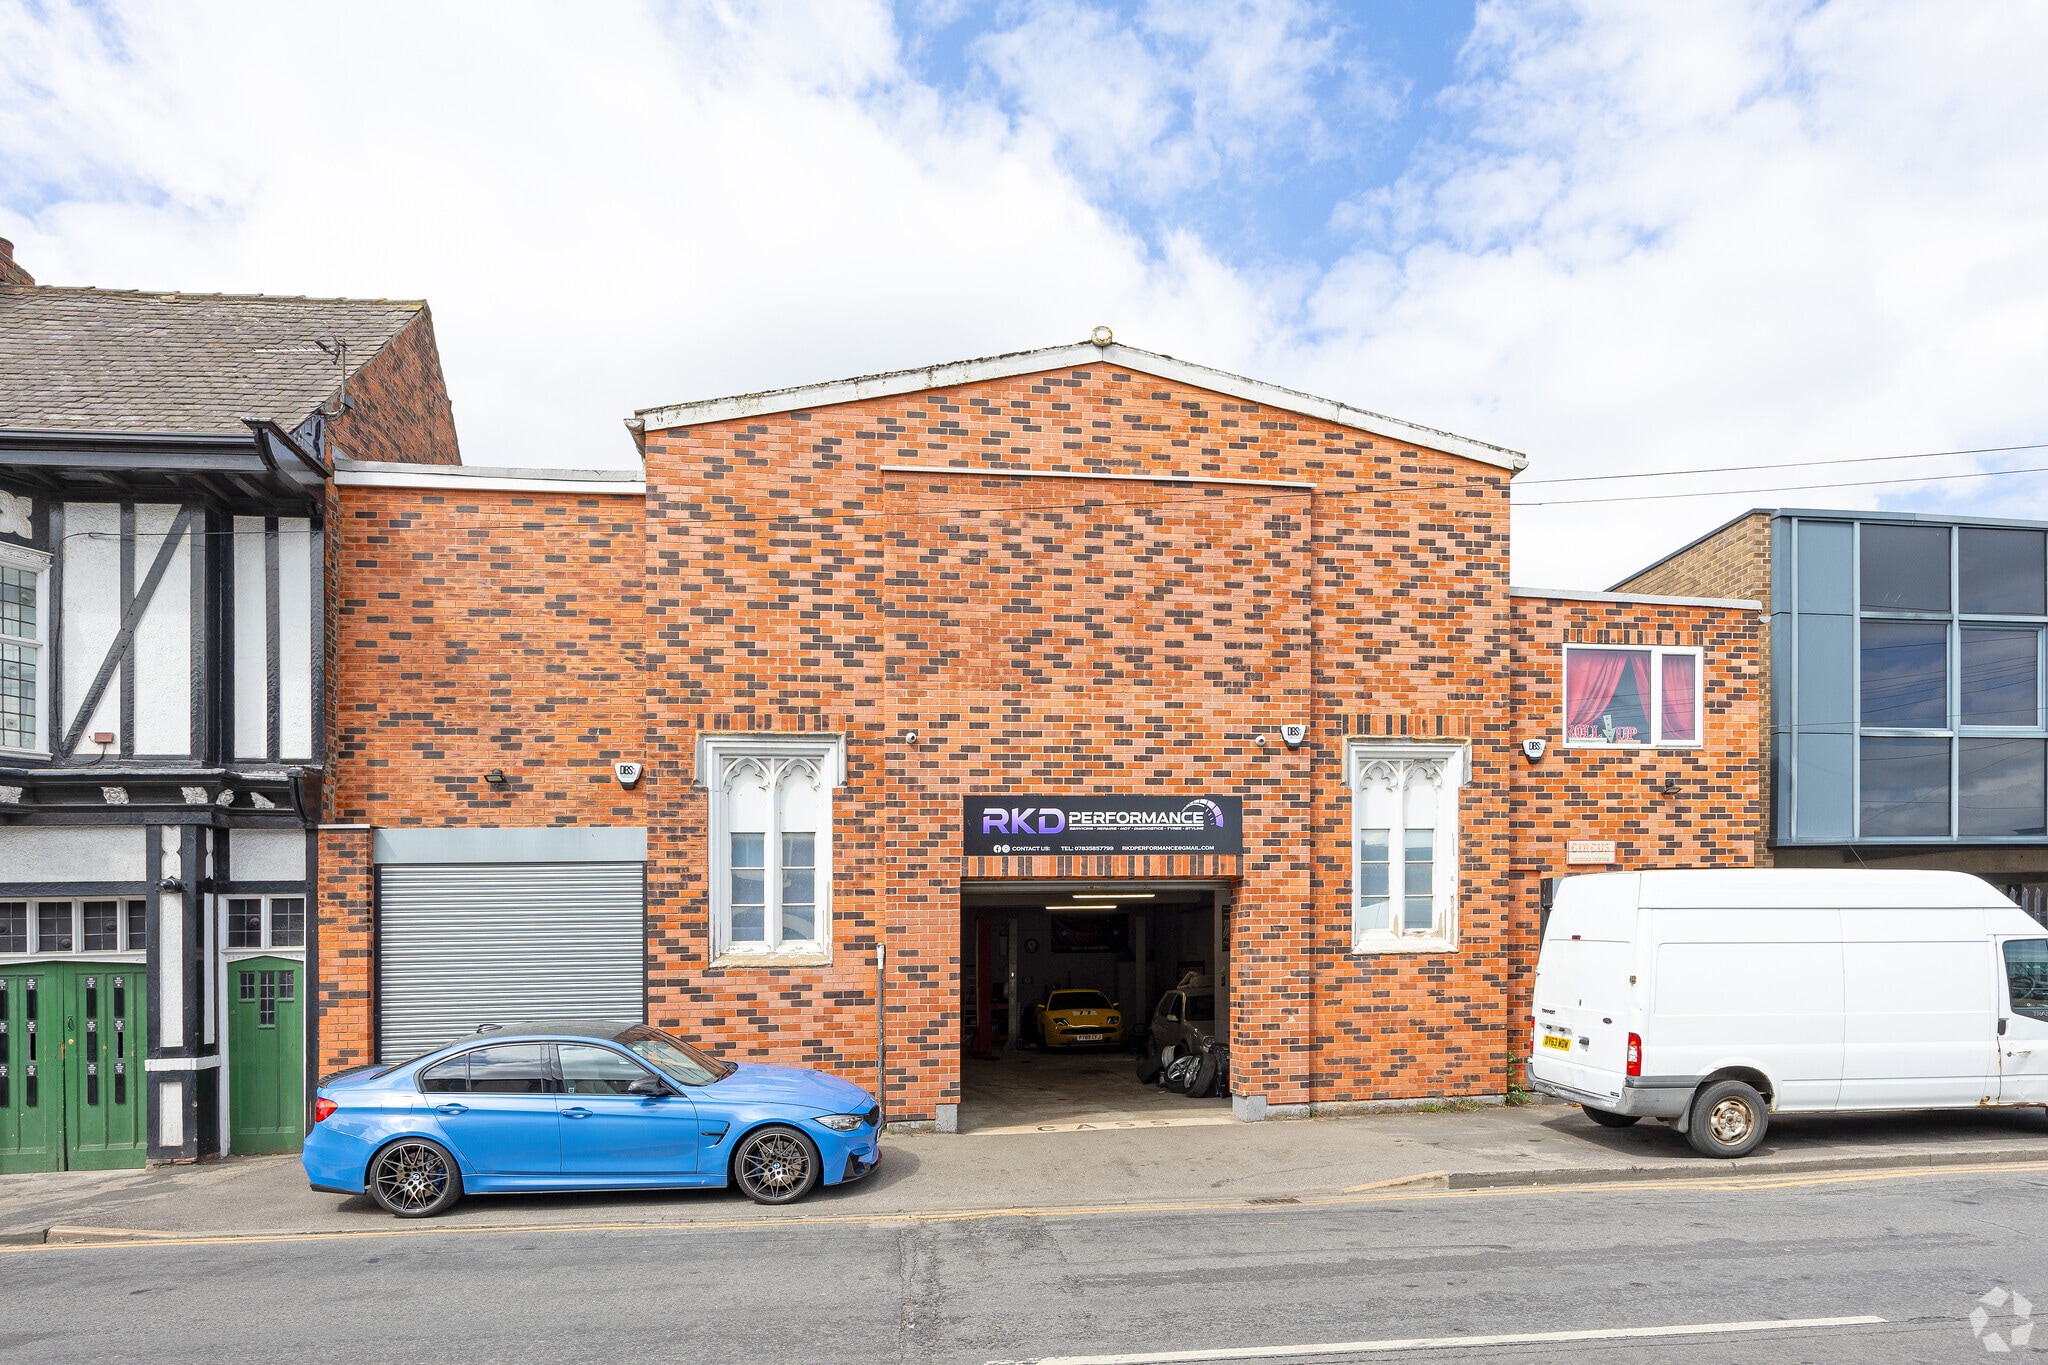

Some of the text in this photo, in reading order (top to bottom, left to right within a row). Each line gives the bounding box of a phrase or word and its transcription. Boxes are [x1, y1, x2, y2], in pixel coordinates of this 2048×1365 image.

[1287, 726, 1301, 736] DBS
[1567, 724, 1602, 738] ROLL
[1616, 726, 1638, 740] UP
[1528, 741, 1541, 750] DBS
[620, 765, 635, 775] DBS
[982, 807, 1205, 834] RKD PERFORMANCE
[1571, 843, 1611, 852] CIRCUS
